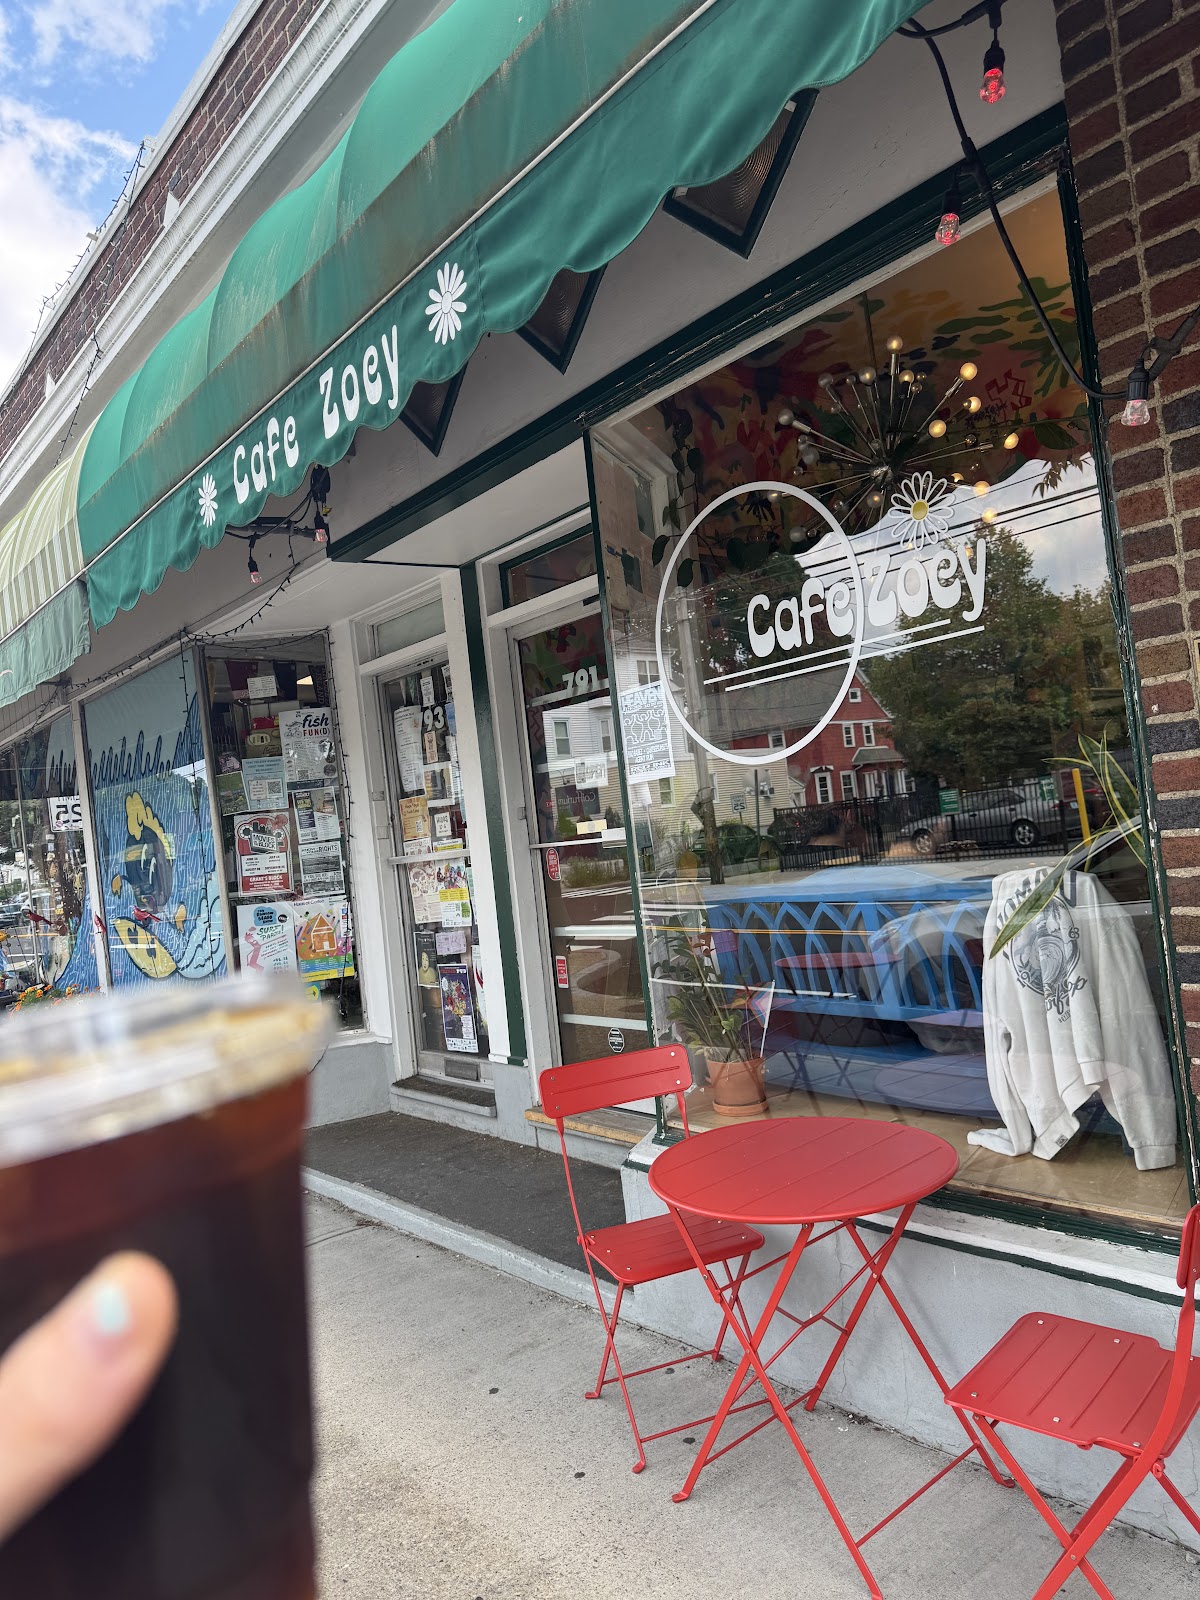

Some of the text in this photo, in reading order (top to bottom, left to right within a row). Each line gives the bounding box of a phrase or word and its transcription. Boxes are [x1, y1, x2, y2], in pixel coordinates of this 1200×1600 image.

[233, 325, 399, 504] Cafe Zoey
[747, 538, 986, 657] Cafe Zoey
[562, 665, 600, 693] 791
[302, 713, 329, 728] fish
[423, 706, 445, 731] 93
[303, 727, 330, 737] FUN(D)
[1068, 927, 1079, 939] 63
